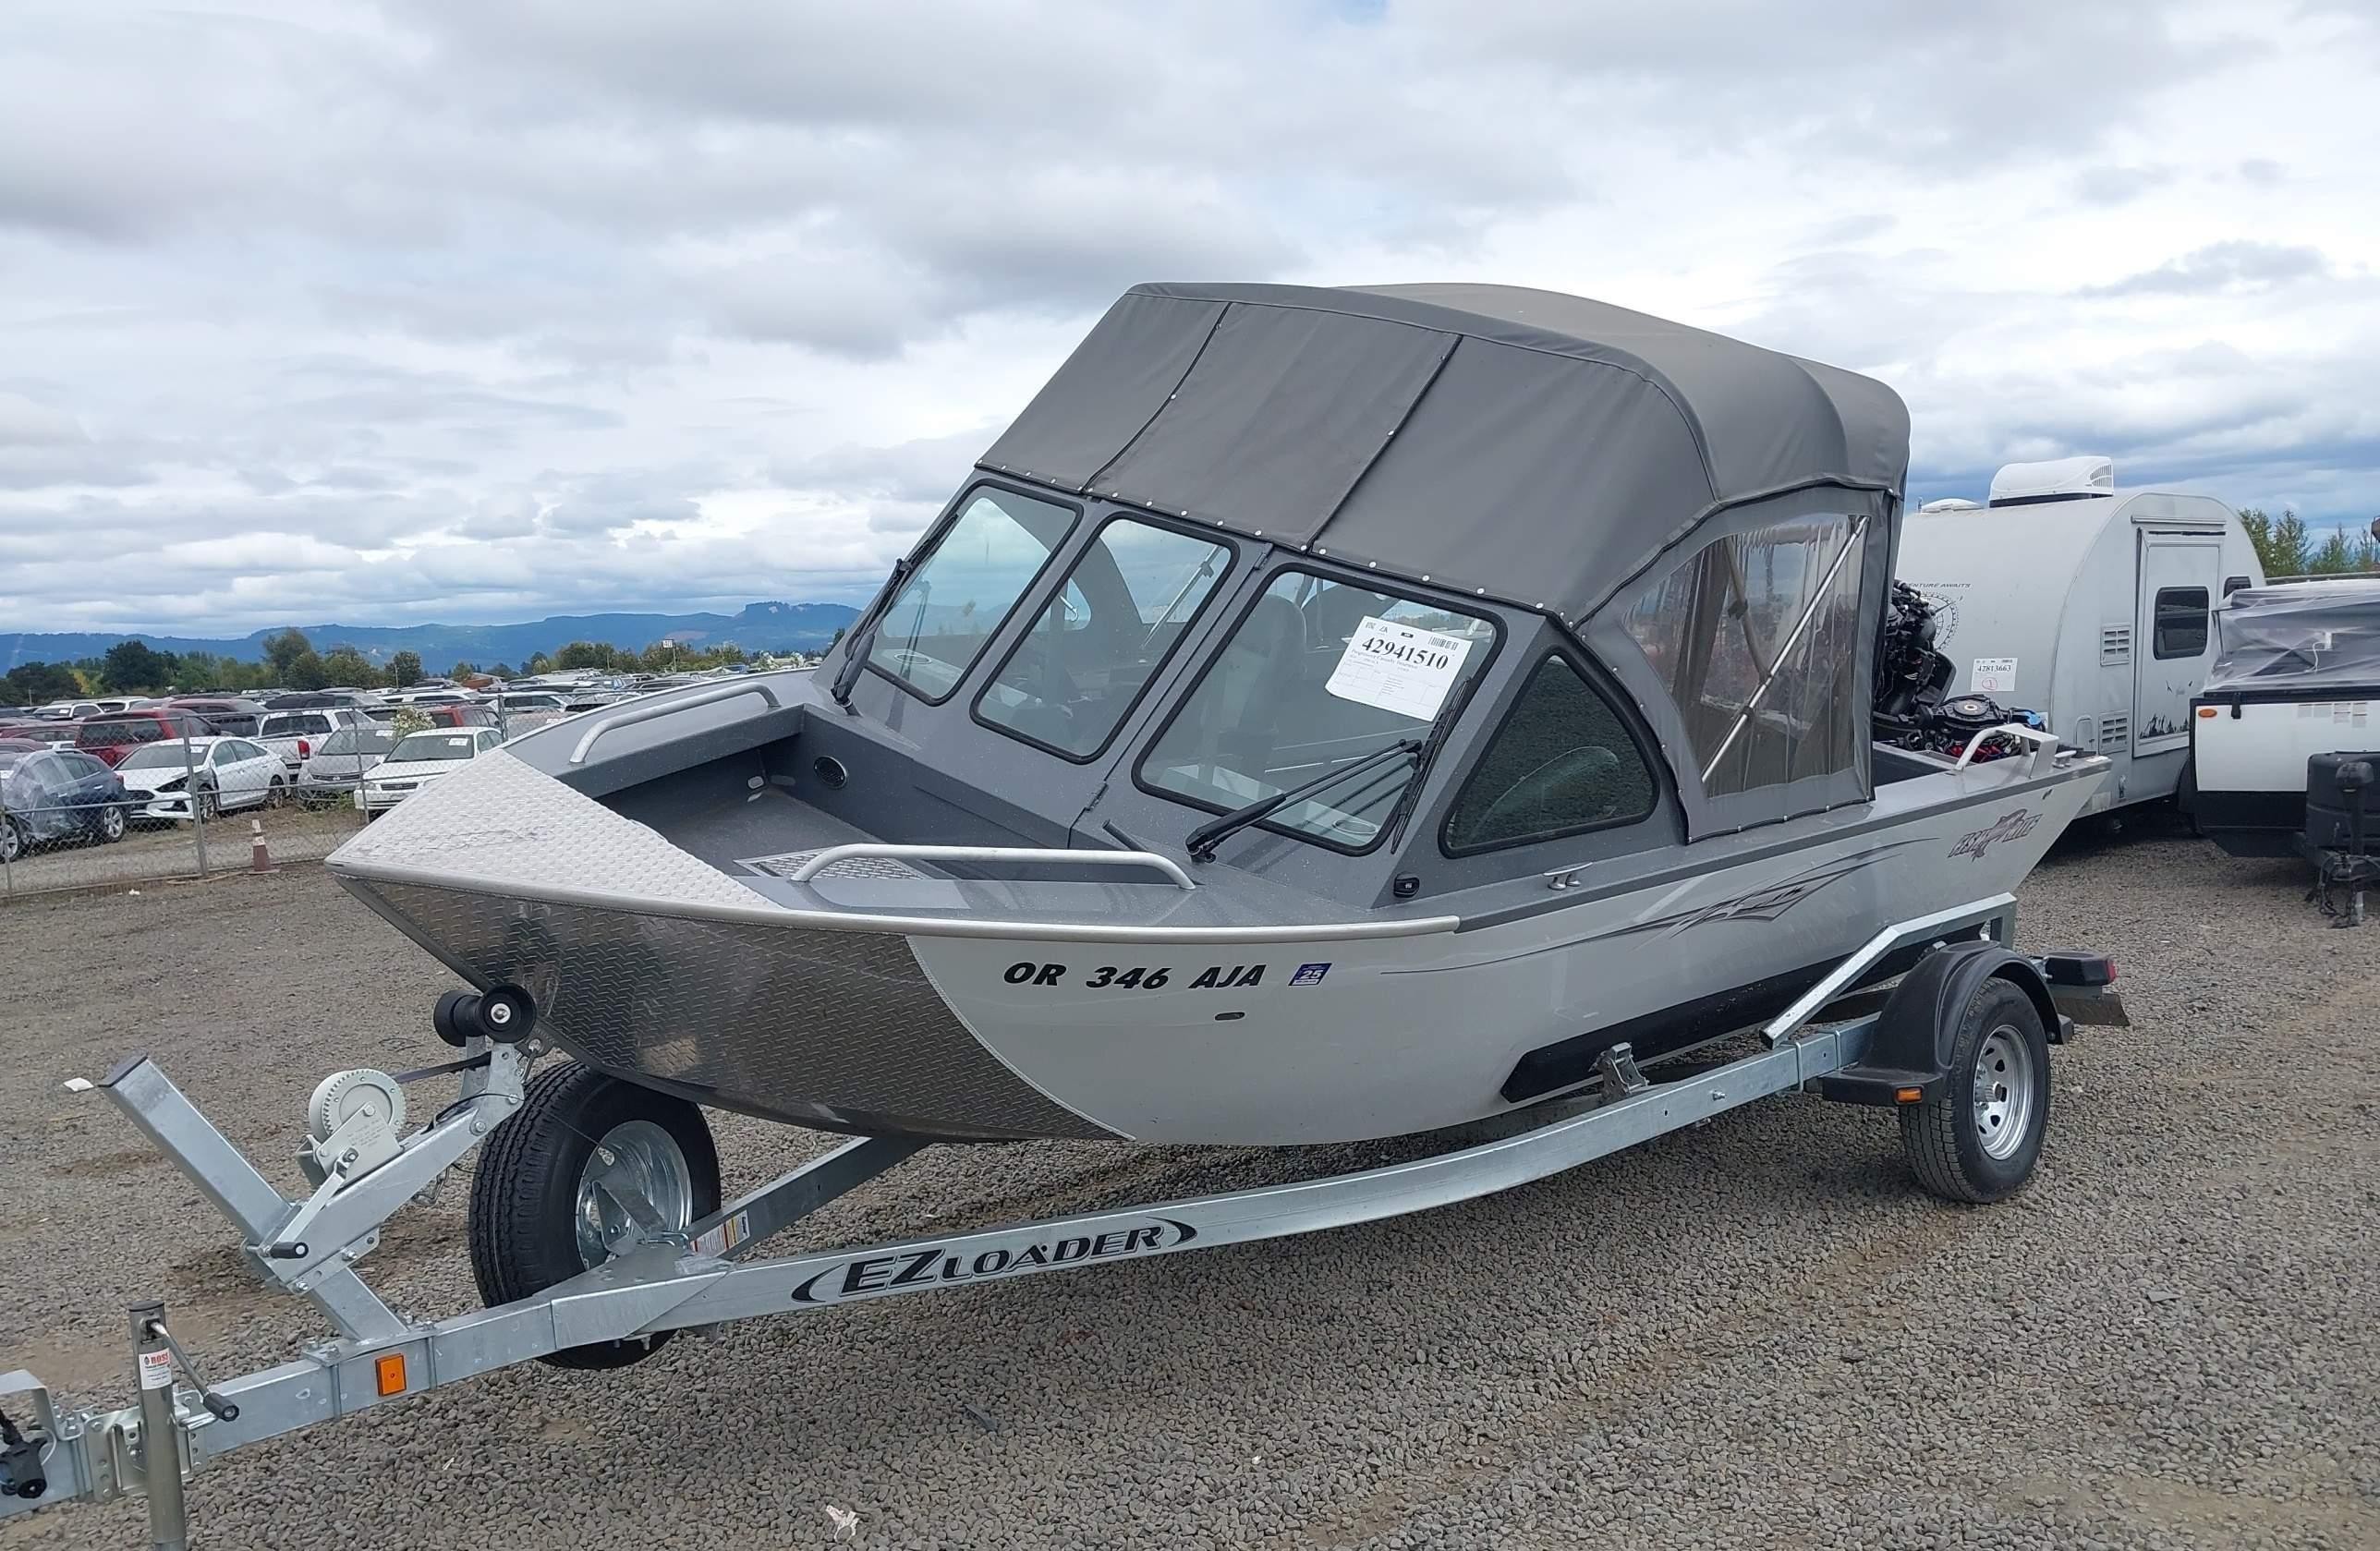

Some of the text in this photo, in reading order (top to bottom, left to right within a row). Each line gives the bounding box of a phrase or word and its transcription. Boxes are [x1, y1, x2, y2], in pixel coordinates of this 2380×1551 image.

[1362, 637, 1449, 670] 42941510
[1977, 664, 2011, 673] 42813663
[1002, 962, 1268, 990] OR 346 AJA
[1301, 970, 1324, 979] 25
